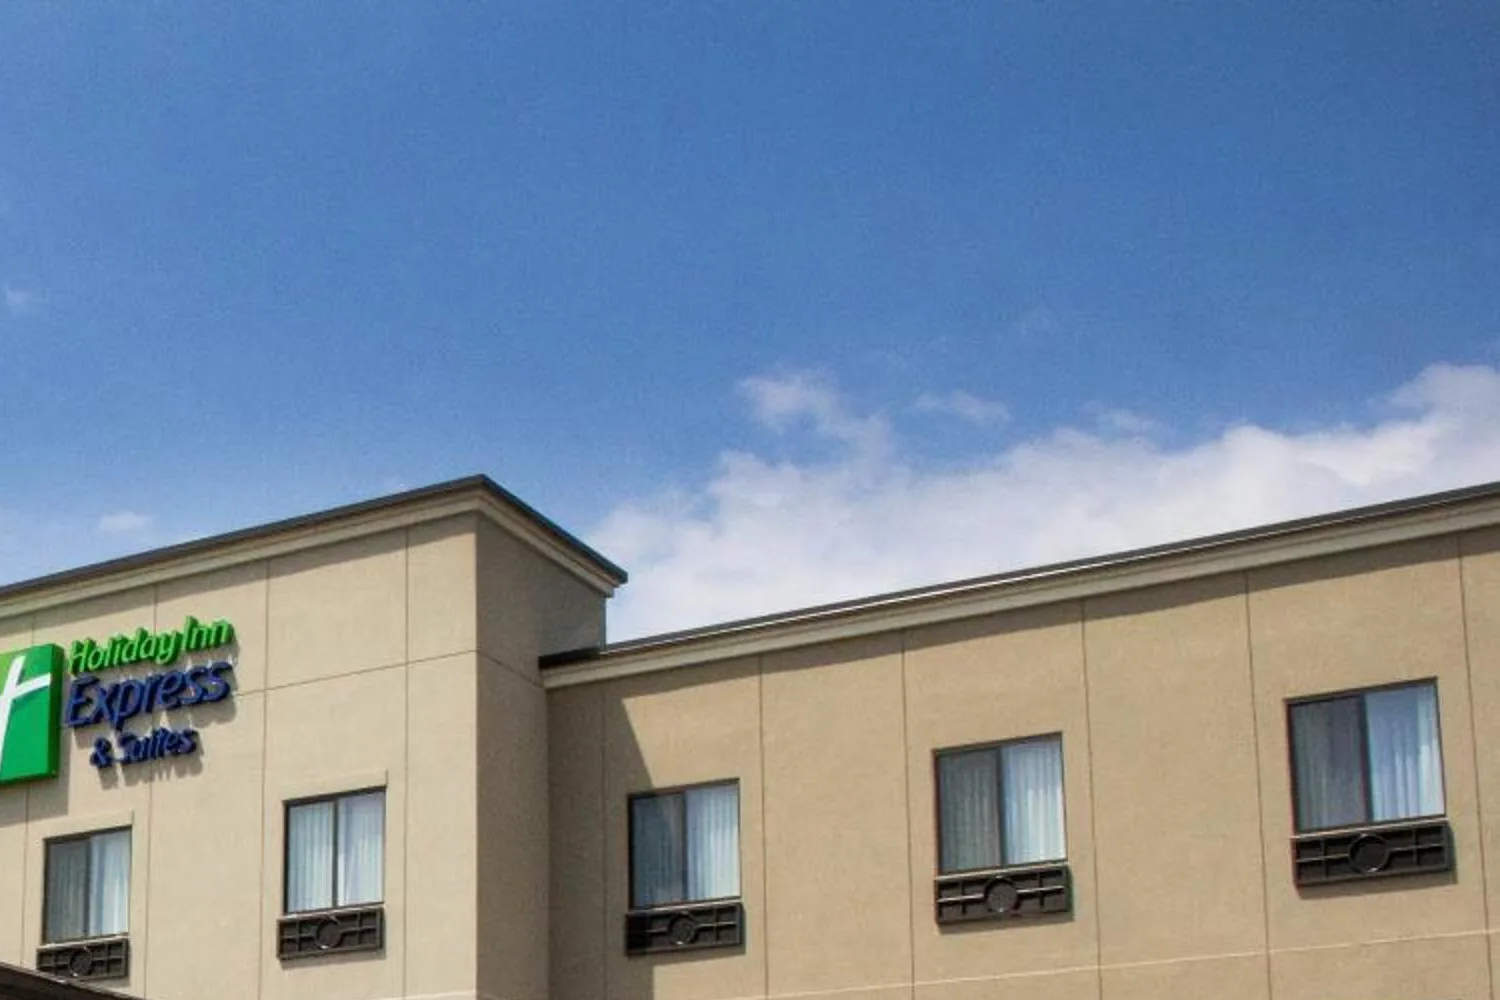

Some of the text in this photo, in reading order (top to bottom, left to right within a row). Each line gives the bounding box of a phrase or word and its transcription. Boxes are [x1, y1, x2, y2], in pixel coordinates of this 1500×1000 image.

[67, 616, 235, 675] Holiday Inn
[65, 661, 233, 731] Express
[90, 727, 199, 769] & Suites
